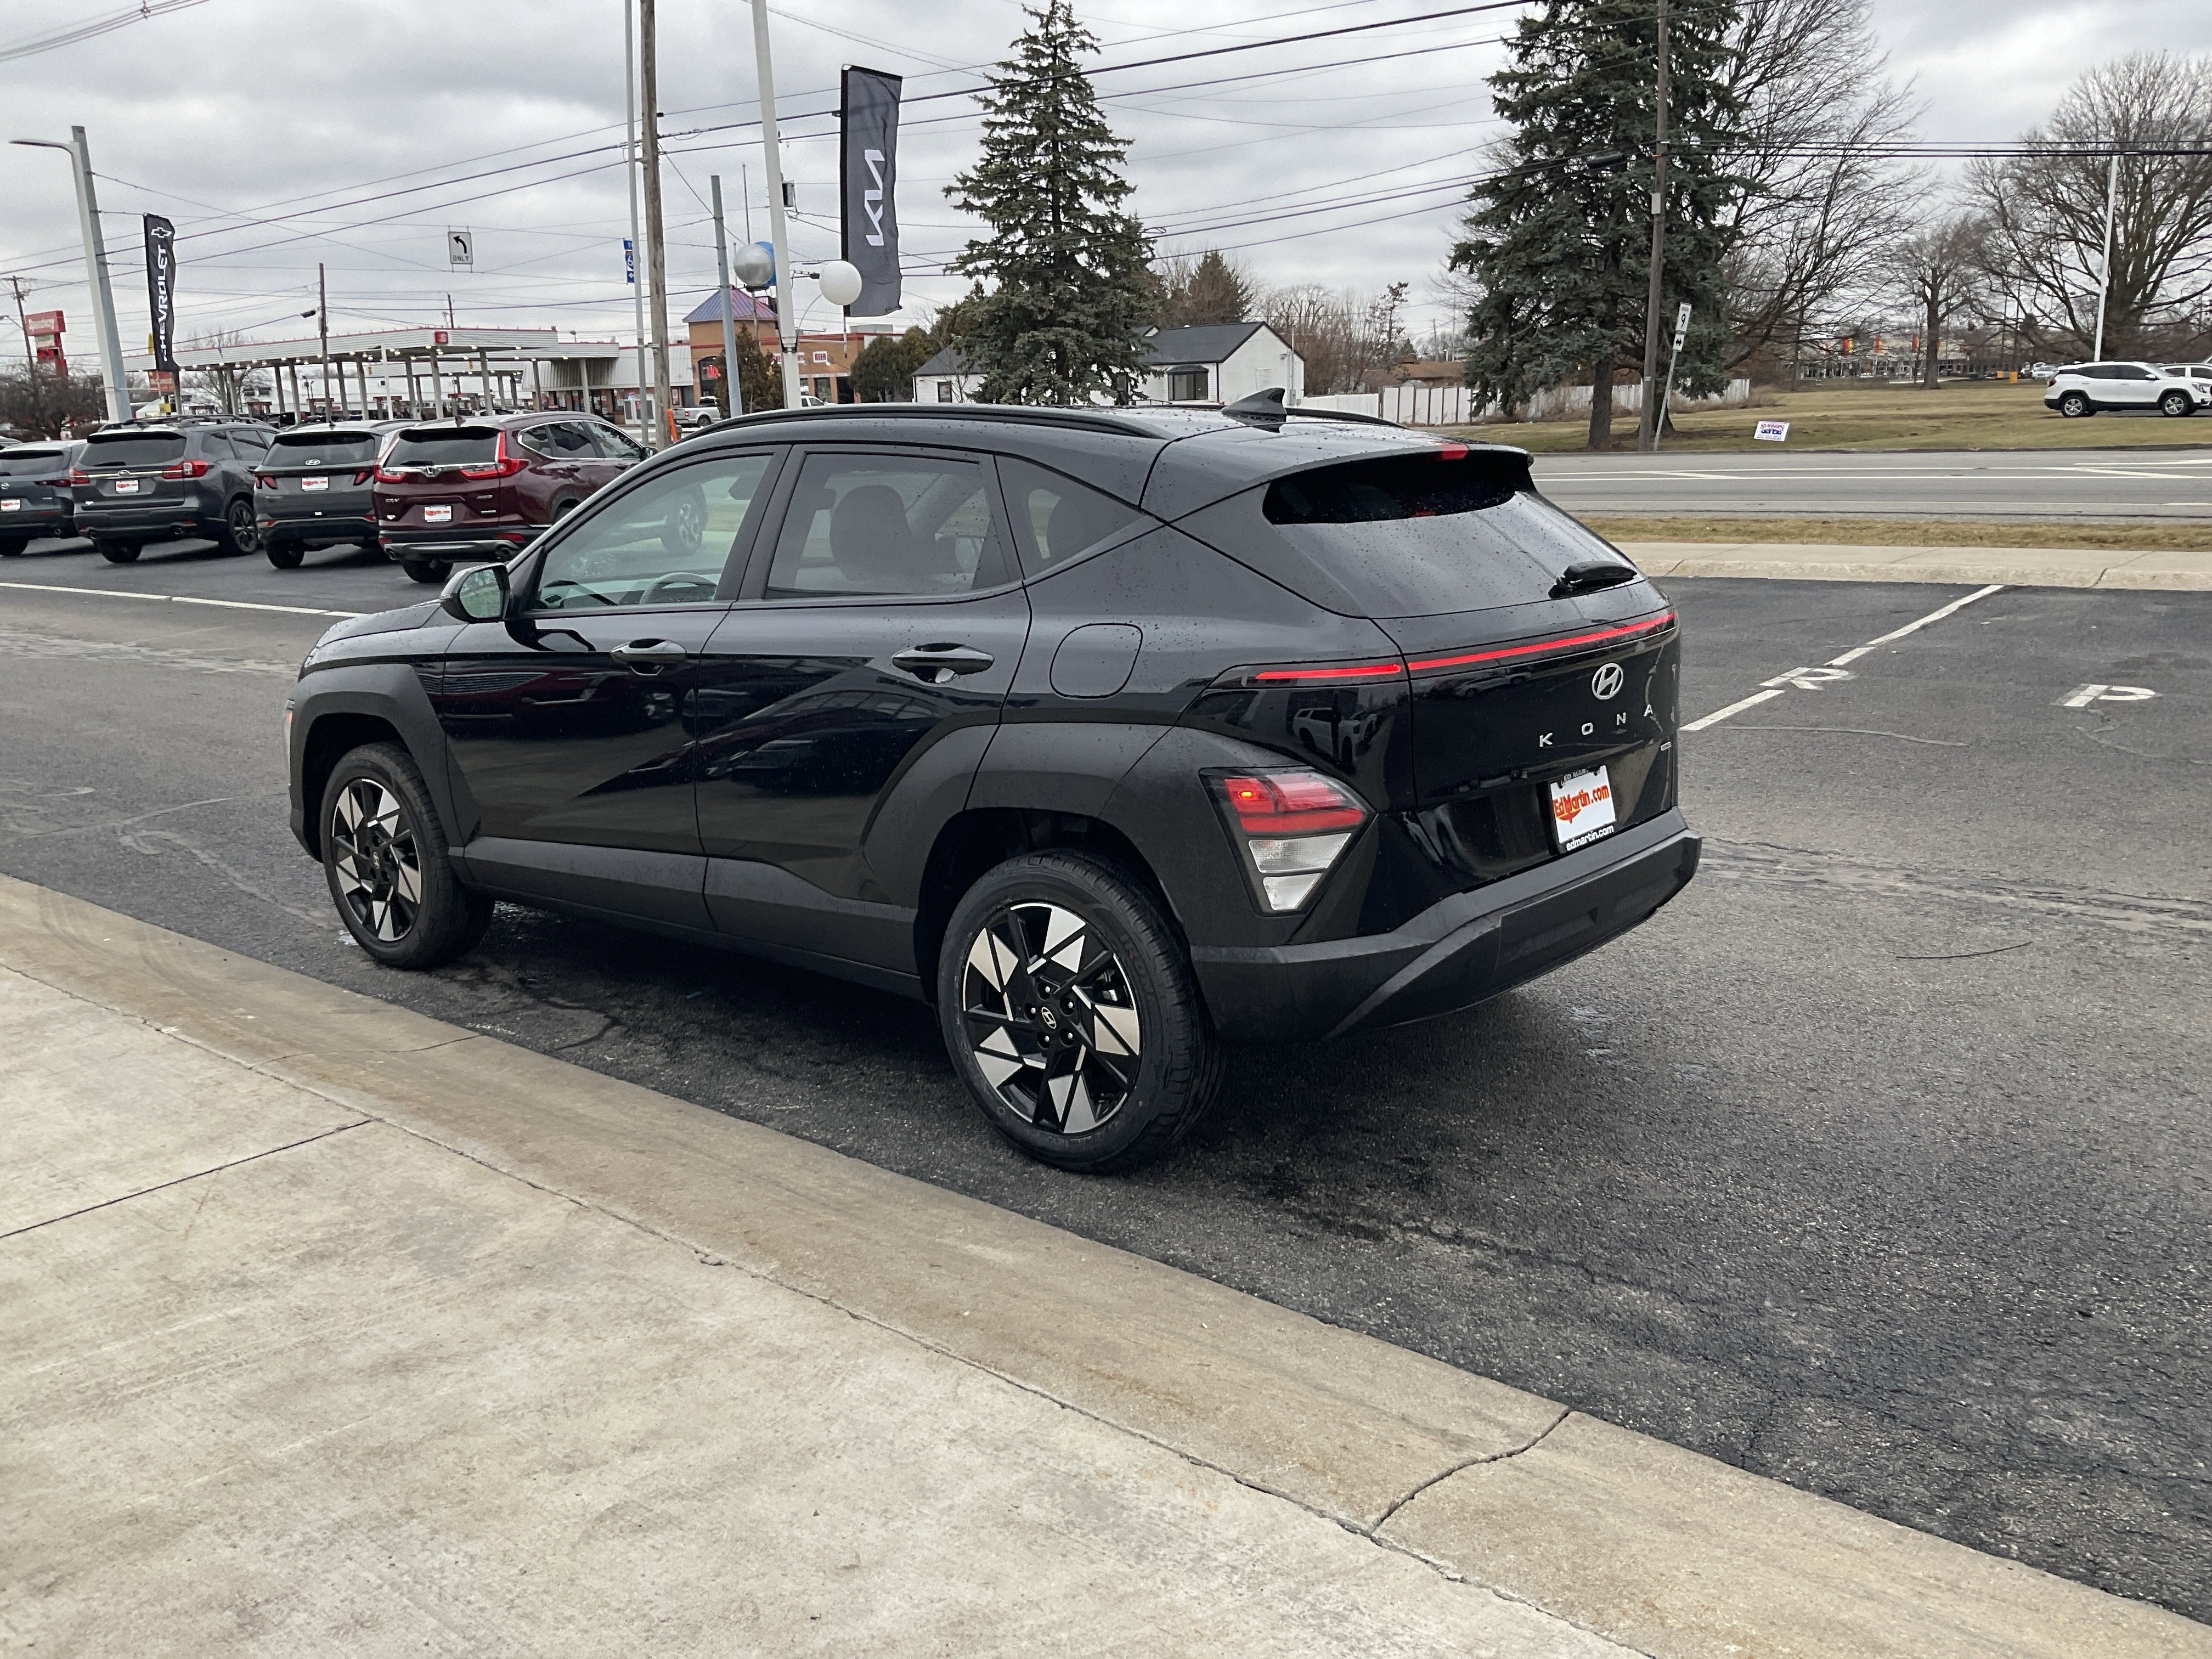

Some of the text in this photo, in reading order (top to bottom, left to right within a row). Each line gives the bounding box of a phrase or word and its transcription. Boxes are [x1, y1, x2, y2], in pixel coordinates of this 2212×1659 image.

[865, 149, 885, 246] KIA
[627, 256, 633, 267] 6
[1681, 313, 1686, 328] 9
[1539, 704, 1654, 748] KONA
[1564, 774, 1572, 782] ED
[1553, 785, 1610, 817] EdMartin.com
[1566, 825, 1614, 851] edmartin.com
